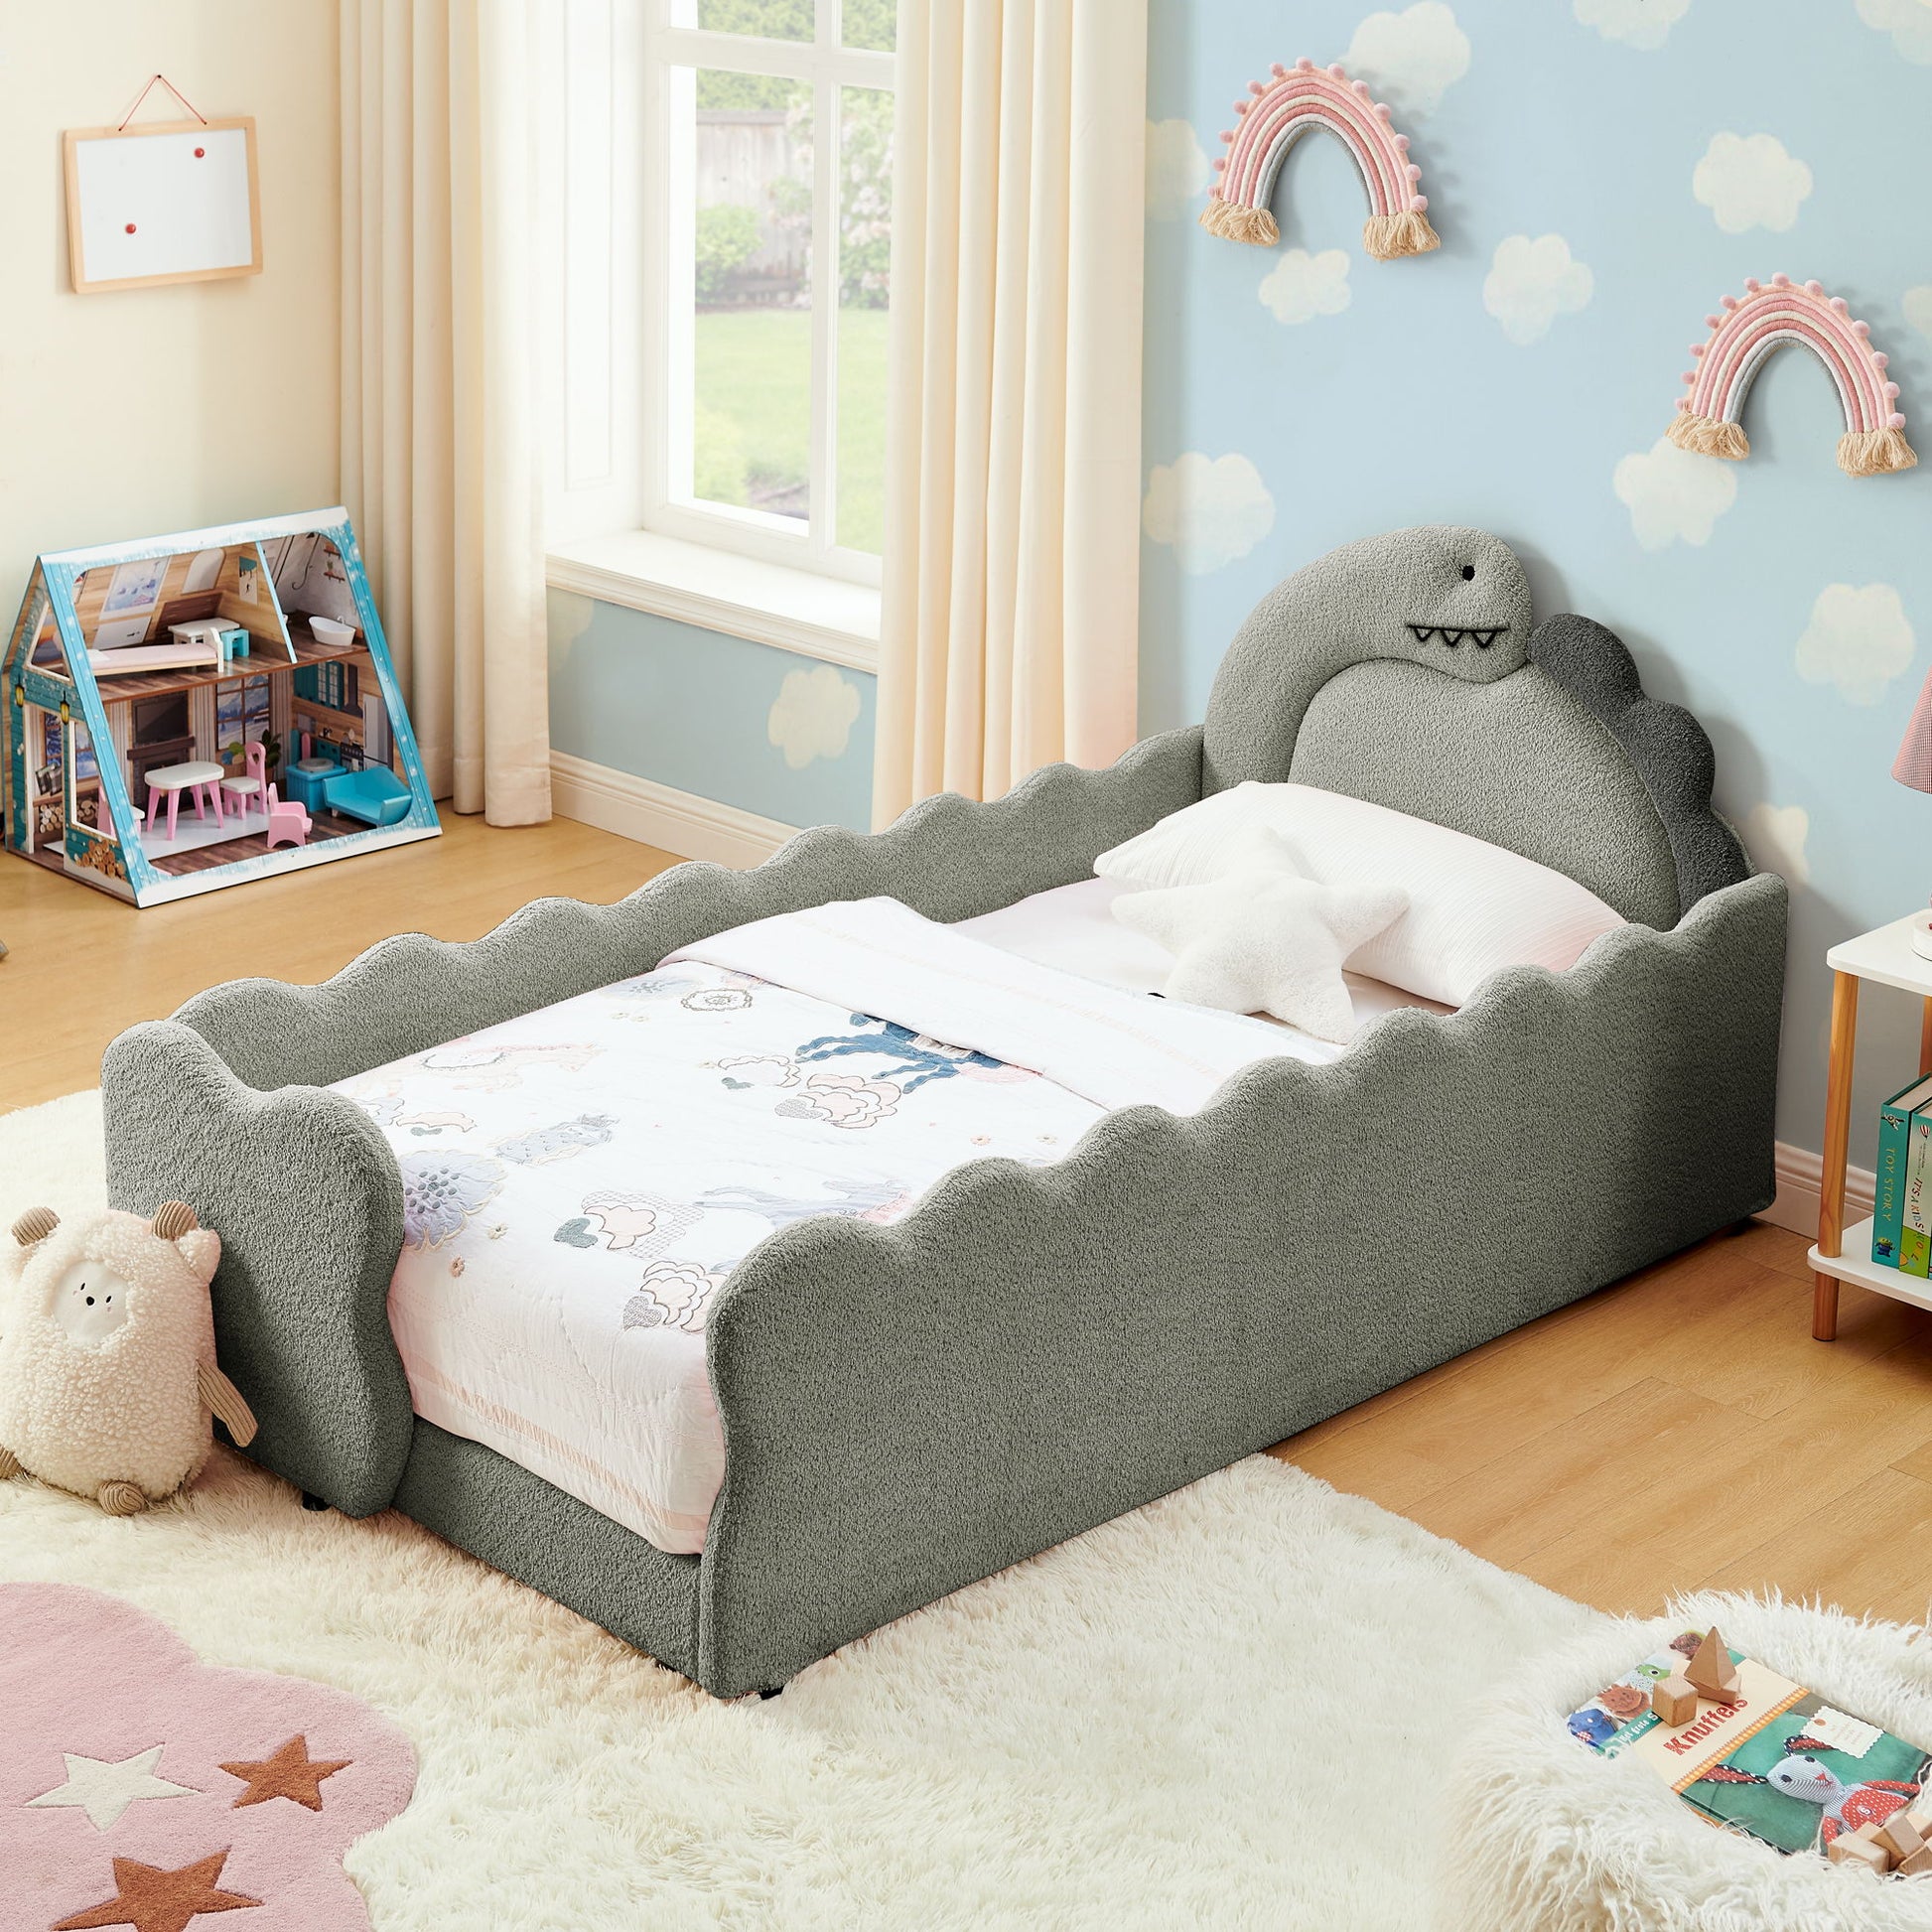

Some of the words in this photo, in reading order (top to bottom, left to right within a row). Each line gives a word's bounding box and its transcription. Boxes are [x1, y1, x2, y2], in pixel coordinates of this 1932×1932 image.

[1885, 1147, 1895, 1174] TOY
[1882, 1177, 1894, 1222] STORY
[1663, 1699, 1748, 1756] Knuffels
